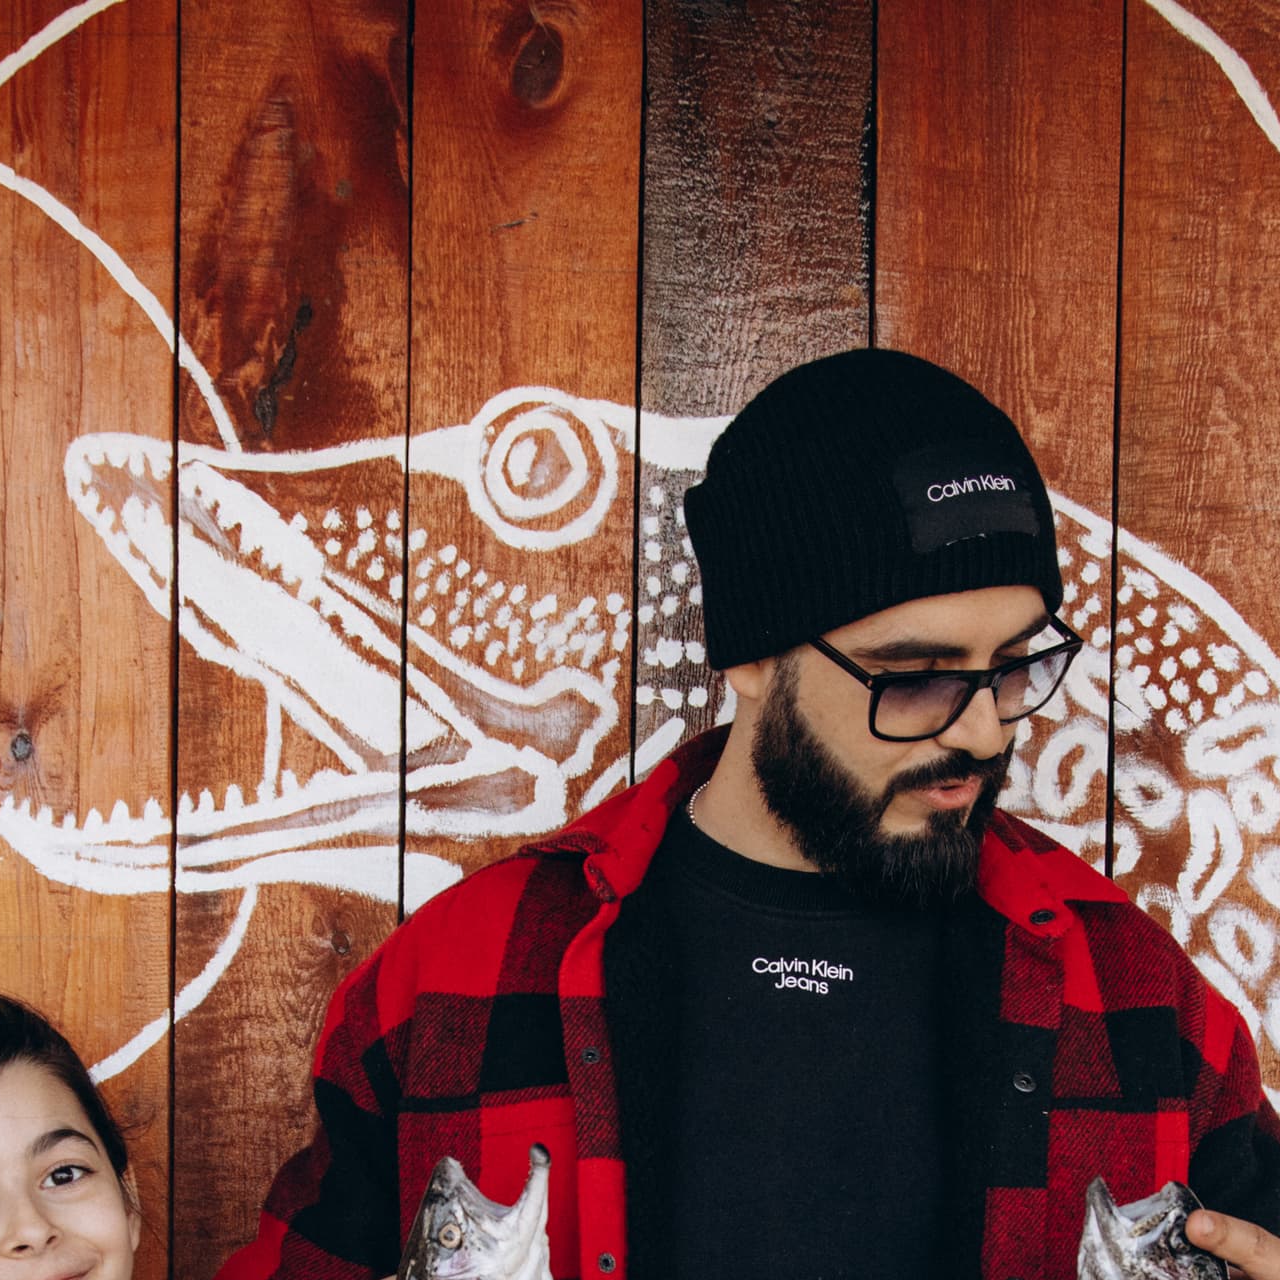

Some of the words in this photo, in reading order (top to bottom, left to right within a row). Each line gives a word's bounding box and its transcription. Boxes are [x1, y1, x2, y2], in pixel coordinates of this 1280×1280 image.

[927, 477, 981, 502] Calvin
[980, 474, 1016, 491] Klein
[752, 957, 809, 973] Calvin
[812, 959, 853, 981] Klein
[775, 973, 829, 994] Jeans
